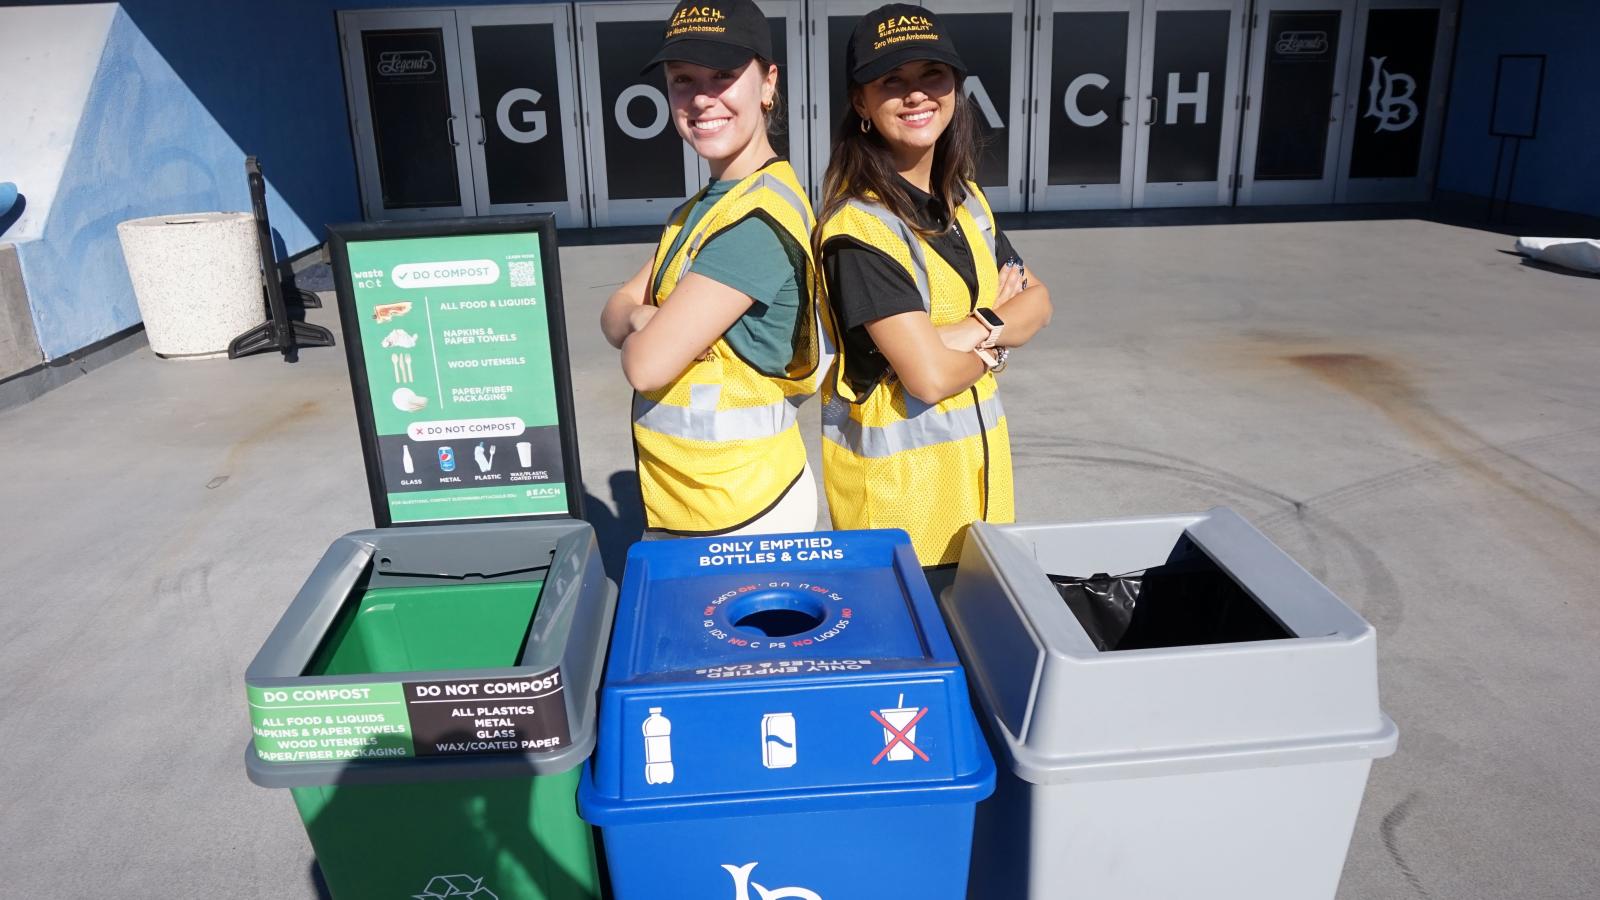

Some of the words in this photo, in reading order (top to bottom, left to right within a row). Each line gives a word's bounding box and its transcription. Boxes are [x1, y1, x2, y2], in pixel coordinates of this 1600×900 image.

[688, 25, 726, 33] Ambassador
[878, 15, 930, 33] BEACH
[879, 25, 930, 37] SUSTAINABILITY
[874, 40, 886, 50] Zero
[887, 36, 905, 44] Waste
[381, 54, 429, 73] Legends
[354, 268, 383, 280] waste
[413, 271, 430, 280] DO
[434, 267, 489, 279] COMPOST
[440, 301, 458, 310] ALL
[460, 300, 488, 310] FOOD
[490, 300, 496, 308] &
[499, 297, 537, 308] LIQUIDS
[443, 328, 485, 338] NAPKINS
[444, 335, 475, 345] PAPER
[477, 333, 518, 343] TOWELS
[448, 360, 479, 369] WOOD
[481, 357, 525, 367] UTENSILS
[452, 385, 513, 395] PAPER/FIBER
[453, 393, 507, 403] PACKAGING
[427, 427, 442, 435] DO
[445, 425, 466, 433] NOT
[469, 422, 516, 432] COMPOST
[474, 473, 502, 481] PLASTIC
[526, 488, 561, 497] BEACH
[708, 541, 753, 553] ONLY
[760, 538, 832, 551] EMPTIED
[700, 552, 775, 566] BOTTLES
[780, 552, 792, 562] &
[797, 549, 844, 561] CANS
[728, 637, 747, 647] NO
[750, 641, 786, 650] CPS
[792, 639, 813, 647] NO
[814, 620, 849, 642] LIQUIDS
[696, 664, 753, 675] CANS
[707, 667, 798, 679] EMPTIED
[807, 664, 863, 672] ONLY
[416, 685, 441, 697] DO
[445, 683, 479, 696] NOT
[483, 672, 560, 694] COMPOST
[263, 691, 288, 703] DO
[292, 688, 371, 701] COMPOST
[451, 708, 474, 717] ALL
[477, 706, 534, 716] PLASTICS
[262, 717, 284, 726] ALL
[286, 716, 322, 726] FOOD
[325, 715, 334, 724] &
[336, 713, 385, 723] LIQUIDS
[475, 718, 514, 727] METAL
[253, 727, 298, 738] NAPKINS
[301, 727, 310, 736] &
[313, 726, 352, 736] PAPER
[354, 724, 405, 735] TOWELS
[477, 729, 516, 739] GLASS
[277, 739, 317, 749] WOOD
[321, 737, 378, 747] UTENSILS
[436, 740, 517, 751] WAX/COATED
[521, 737, 560, 749] PAPER
[258, 749, 333, 761] PAPER/FIBER
[336, 747, 406, 758] PACKAGING
